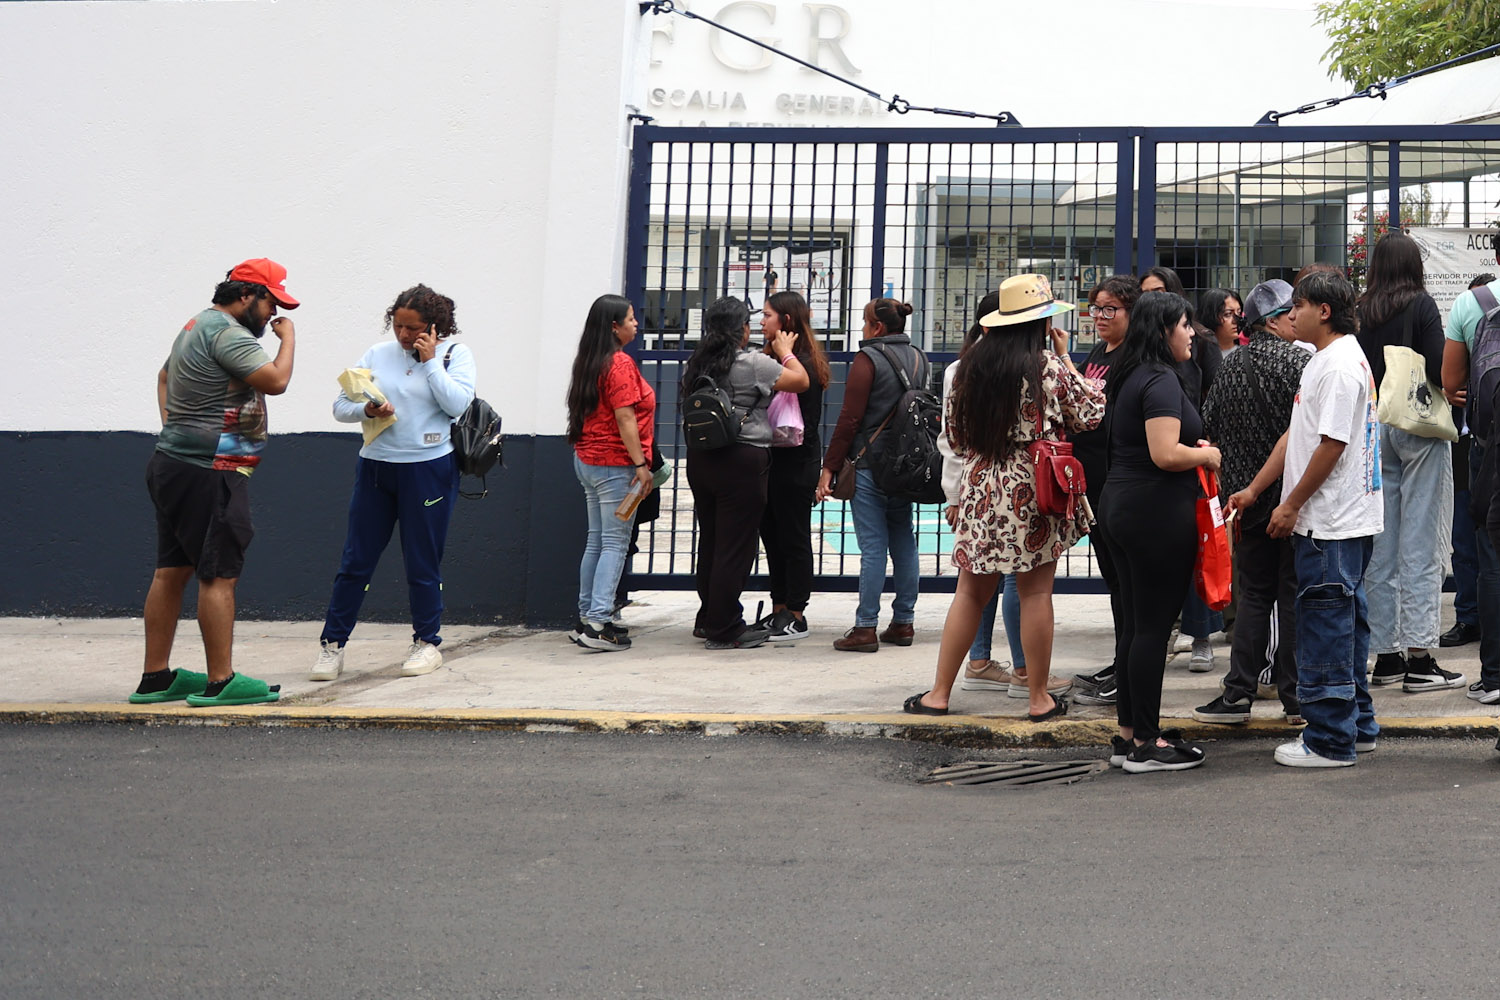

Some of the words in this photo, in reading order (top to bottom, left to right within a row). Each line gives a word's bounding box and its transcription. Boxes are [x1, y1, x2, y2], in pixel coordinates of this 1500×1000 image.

[648, 87, 747, 111] SCALIA
[776, 93, 888, 118] GENERAL
[1466, 234, 1497, 251] ACCE
[1479, 258, 1497, 267] SOLO
